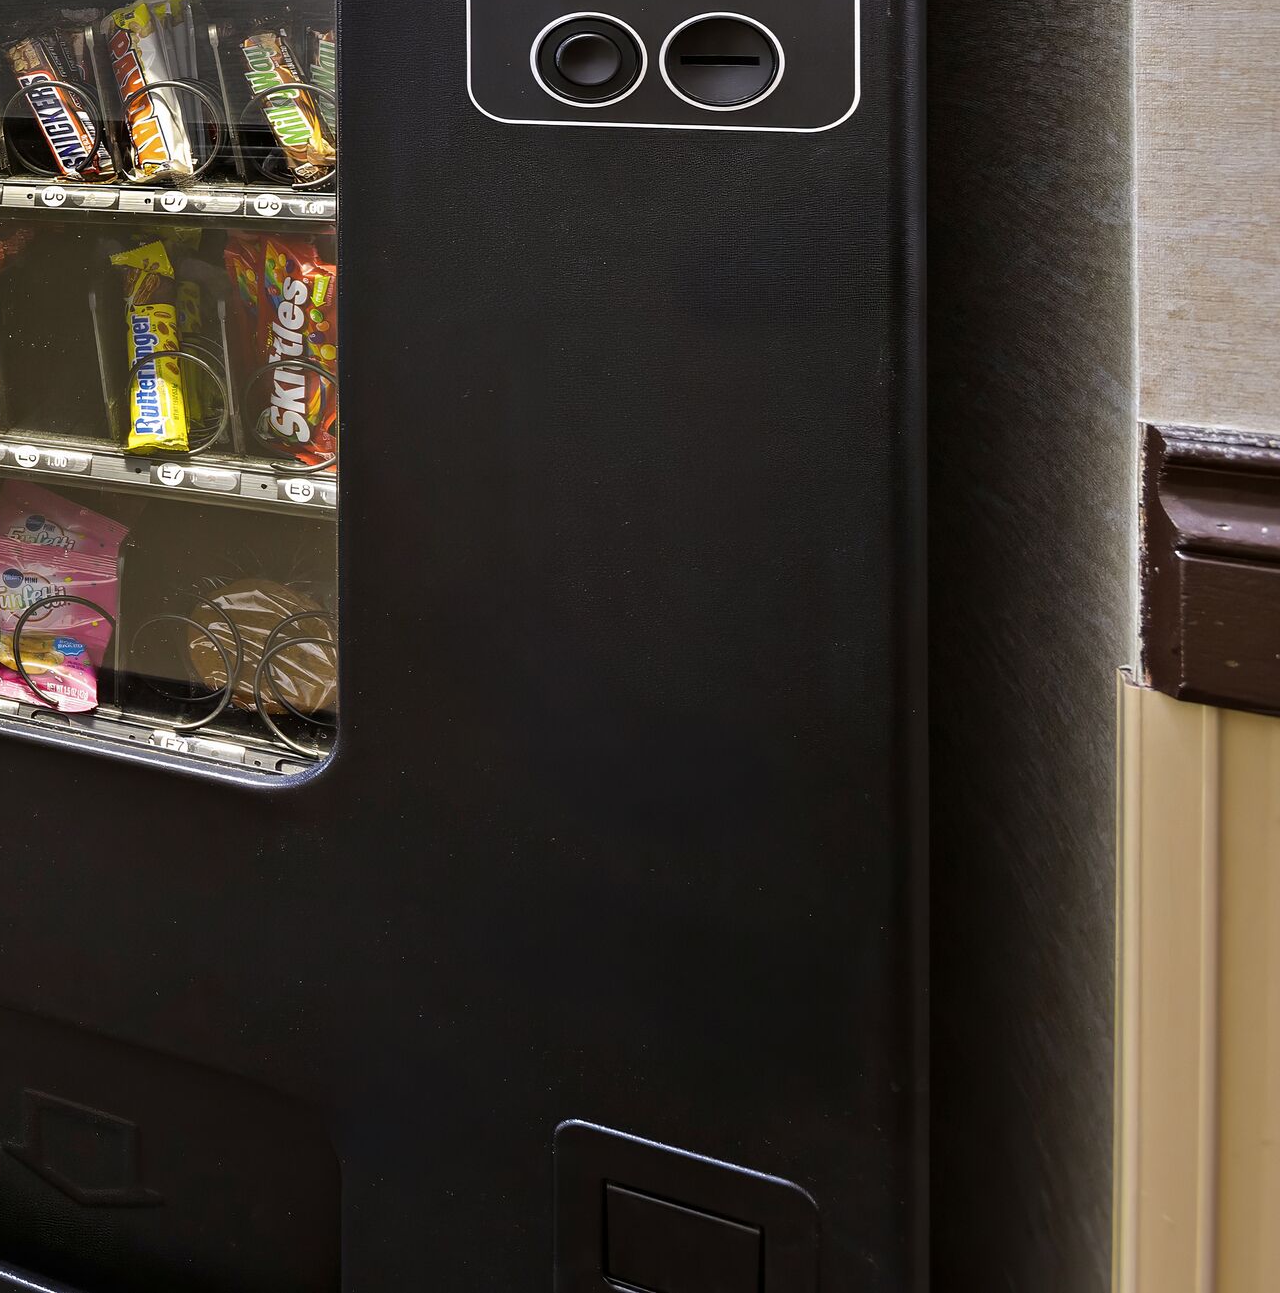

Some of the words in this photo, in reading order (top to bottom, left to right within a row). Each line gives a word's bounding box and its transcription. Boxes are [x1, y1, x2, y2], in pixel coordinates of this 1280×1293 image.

[17, 74, 88, 170] SNICKERS
[269, 277, 310, 443] Skittles
[166, 738, 184, 751] F7
